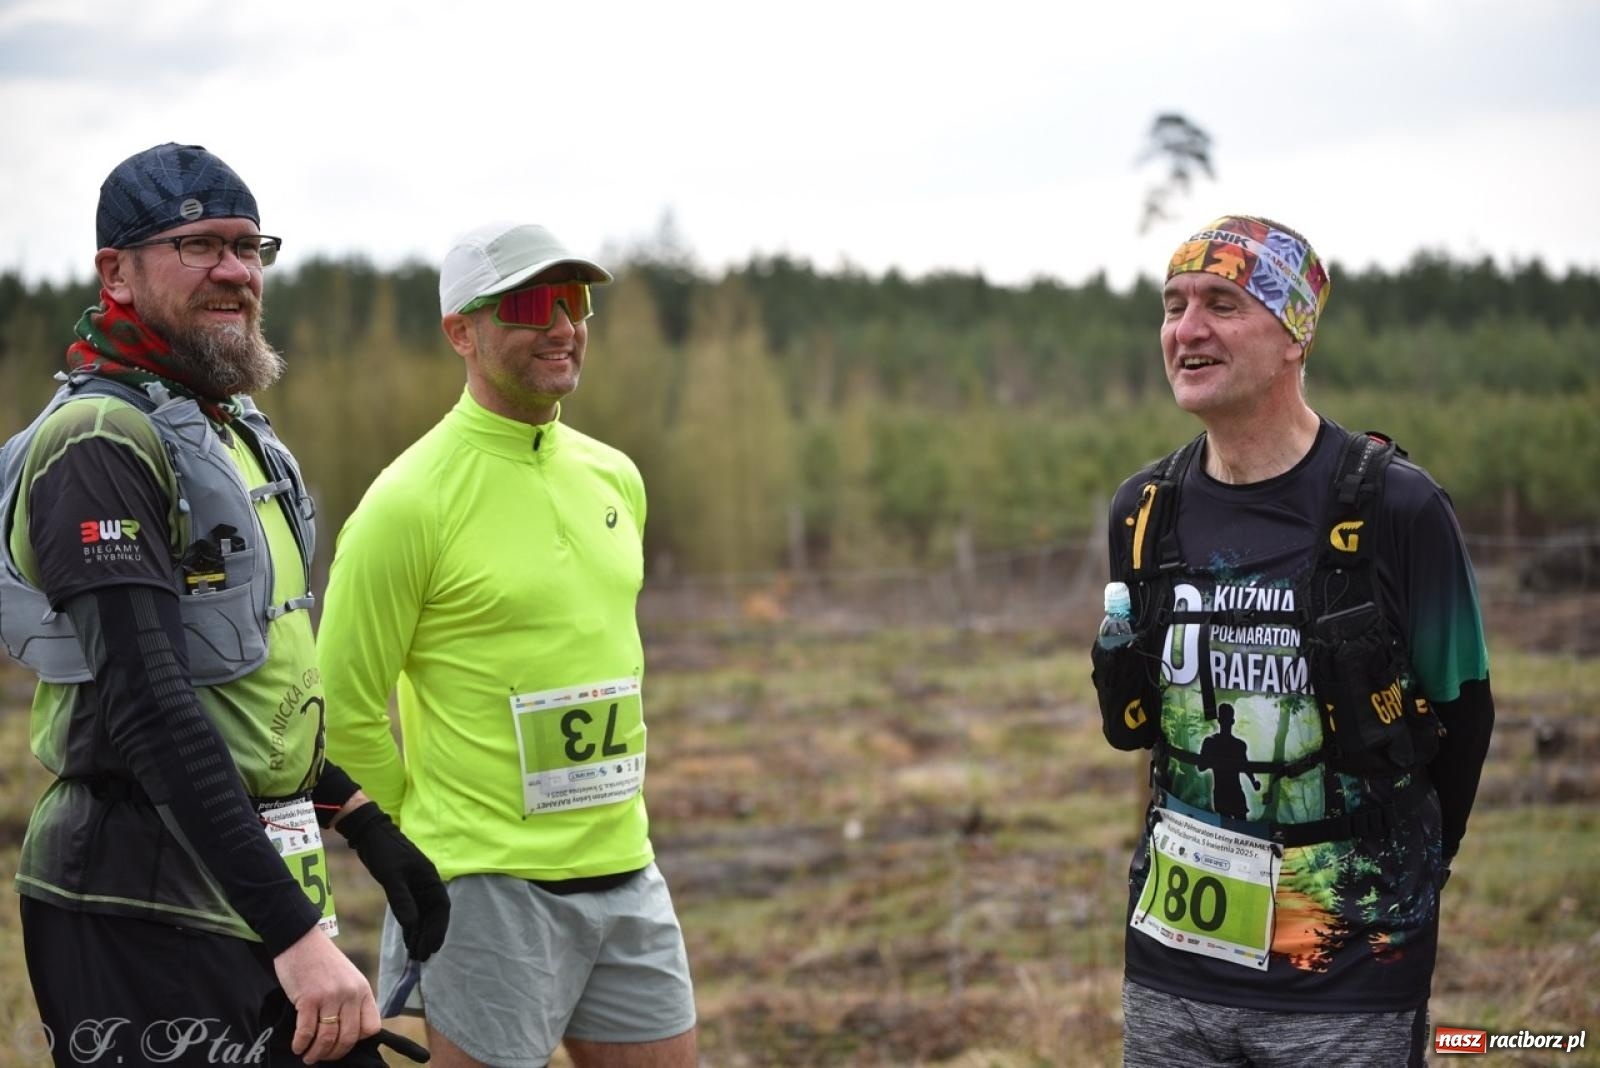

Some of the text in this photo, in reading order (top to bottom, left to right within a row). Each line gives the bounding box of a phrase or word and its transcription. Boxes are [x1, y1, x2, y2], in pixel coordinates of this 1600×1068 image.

[83, 544, 140, 555] BIEGAMY
[560, 702, 627, 762] 73
[1164, 865, 1227, 932] 80
